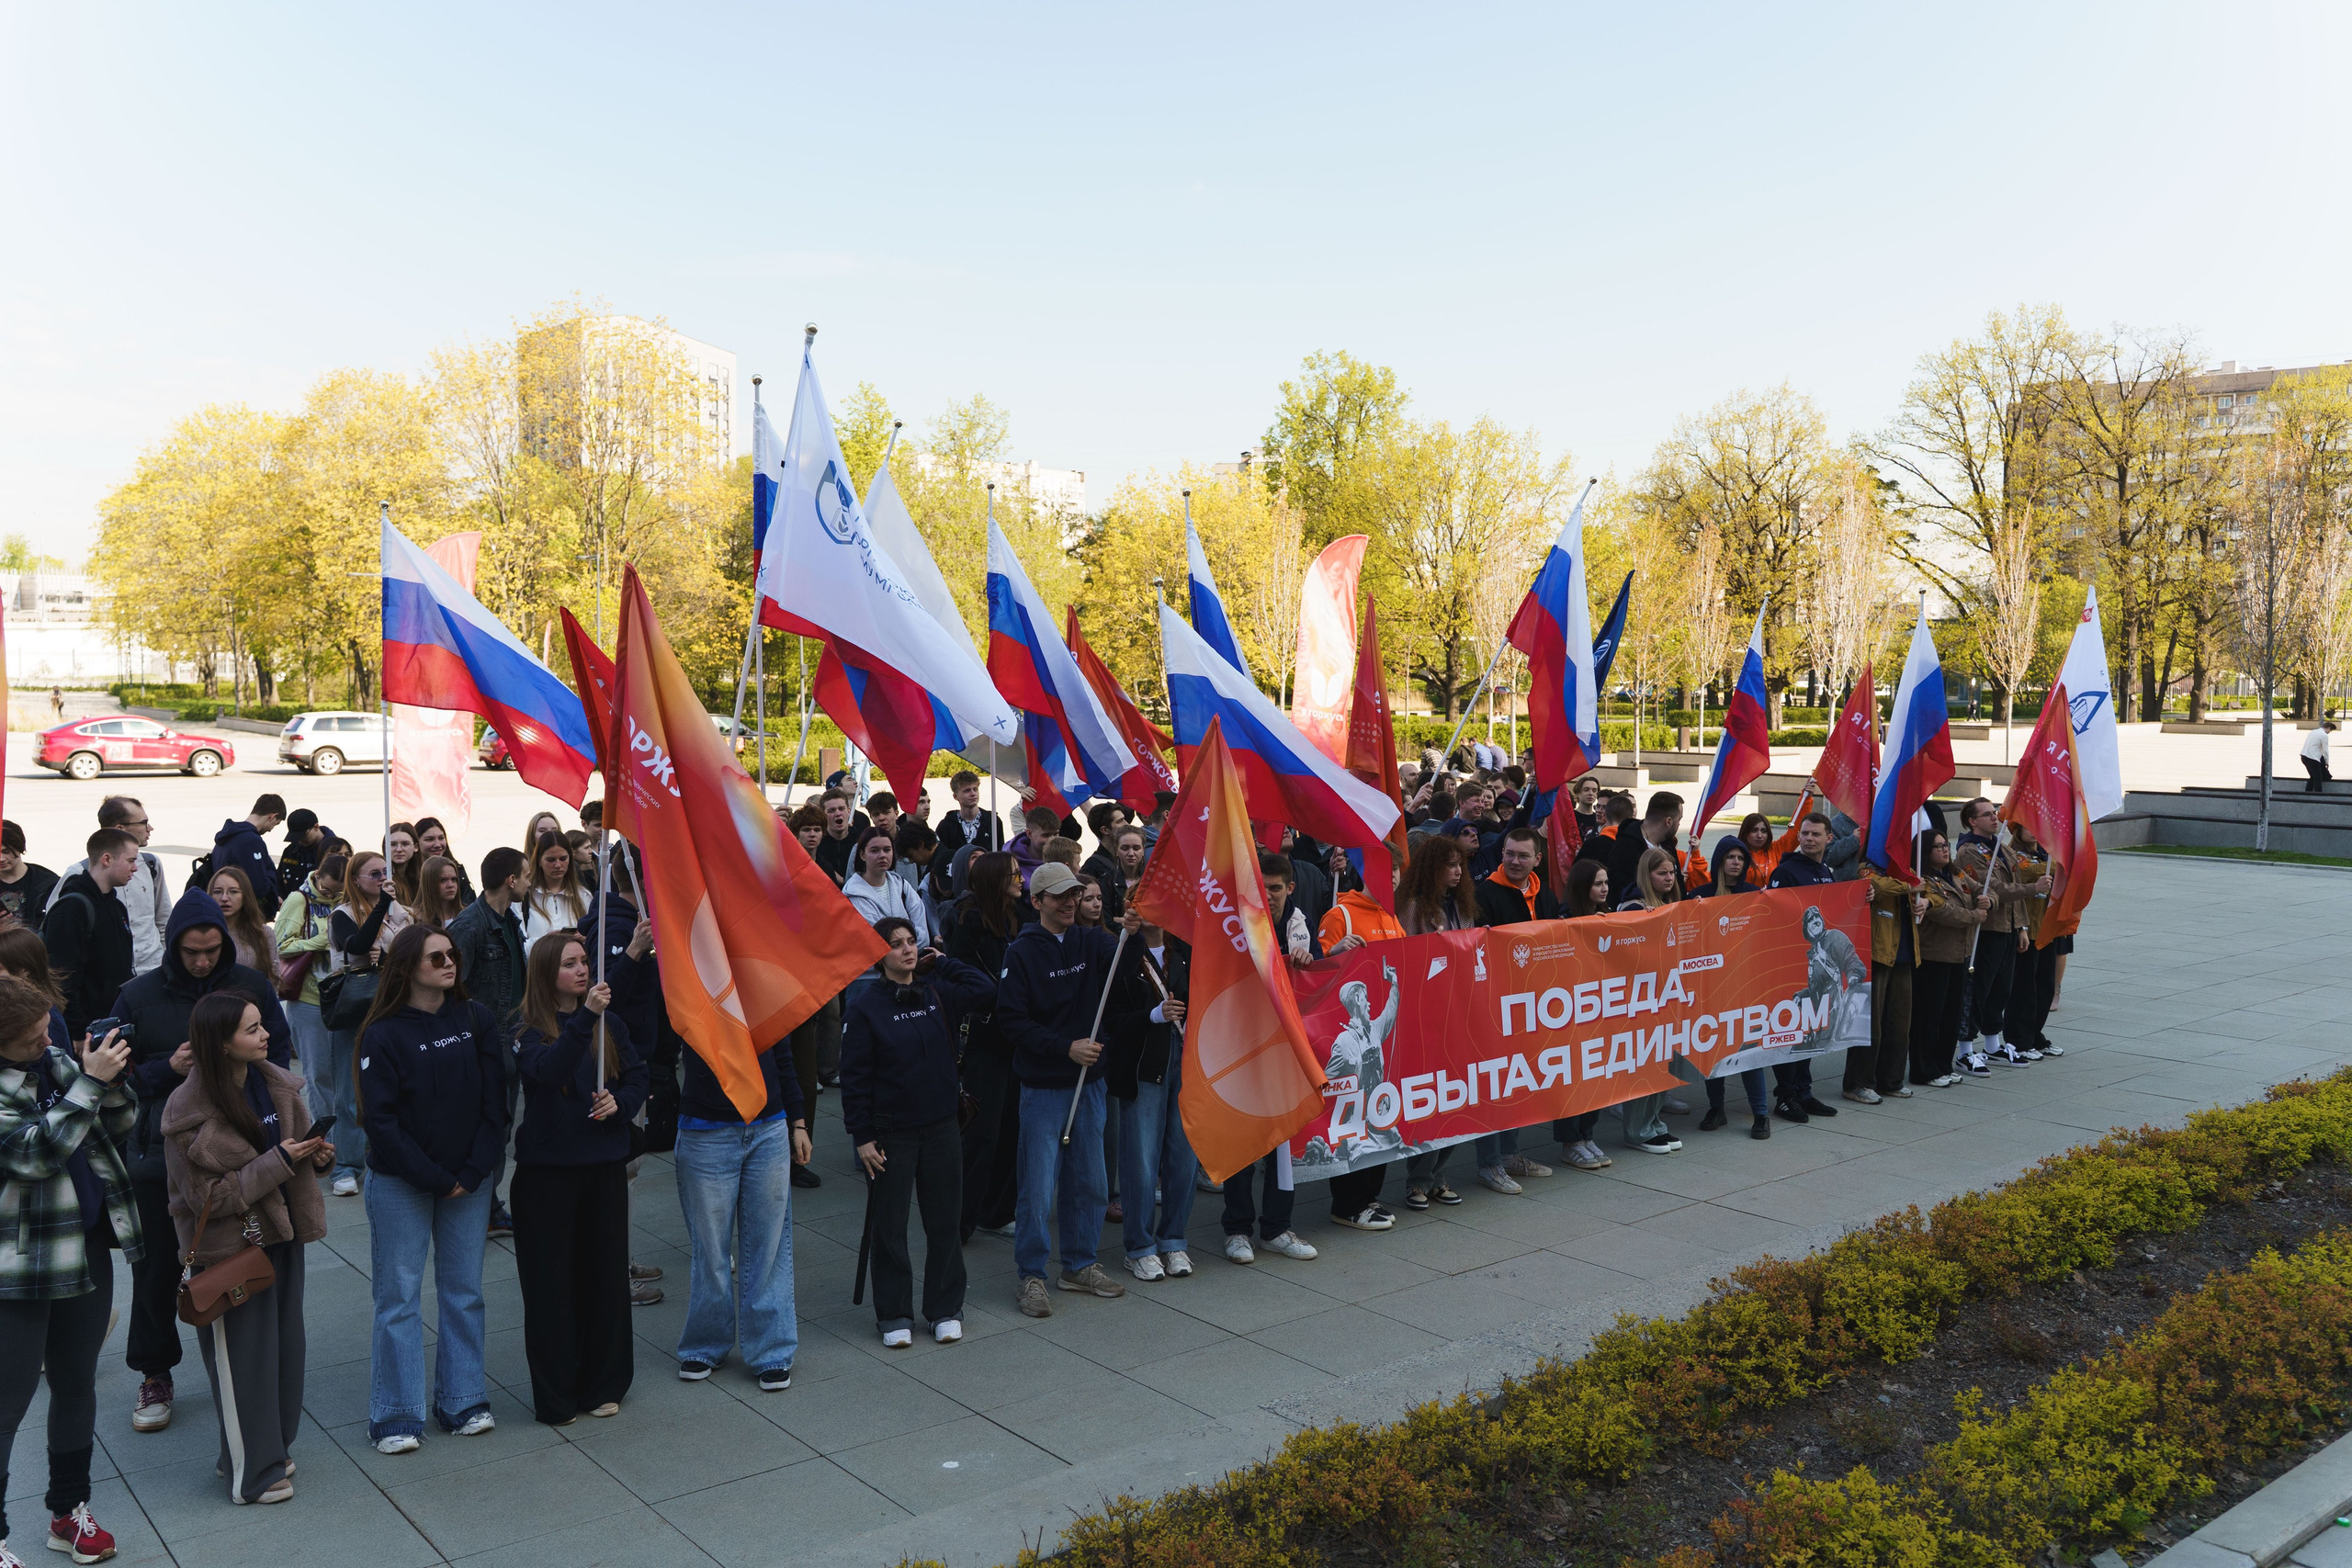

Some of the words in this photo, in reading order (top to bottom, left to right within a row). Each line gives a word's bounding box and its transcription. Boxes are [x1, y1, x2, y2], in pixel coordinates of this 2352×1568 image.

[1621, 935, 1646, 947] горжусь
[1682, 956, 1718, 971] МОСКВА
[1500, 968, 1695, 1036] ПОБЕДА,
[419, 1043, 427, 1052] я
[432, 1031, 472, 1048] оржусь
[1580, 994, 1830, 1081] ЕДИНСТВОМ
[1769, 1033, 1796, 1045] РЖЕВ
[1324, 1079, 1352, 1093] НКА
[1328, 1044, 1572, 1145] ДОБЫТАЯ
